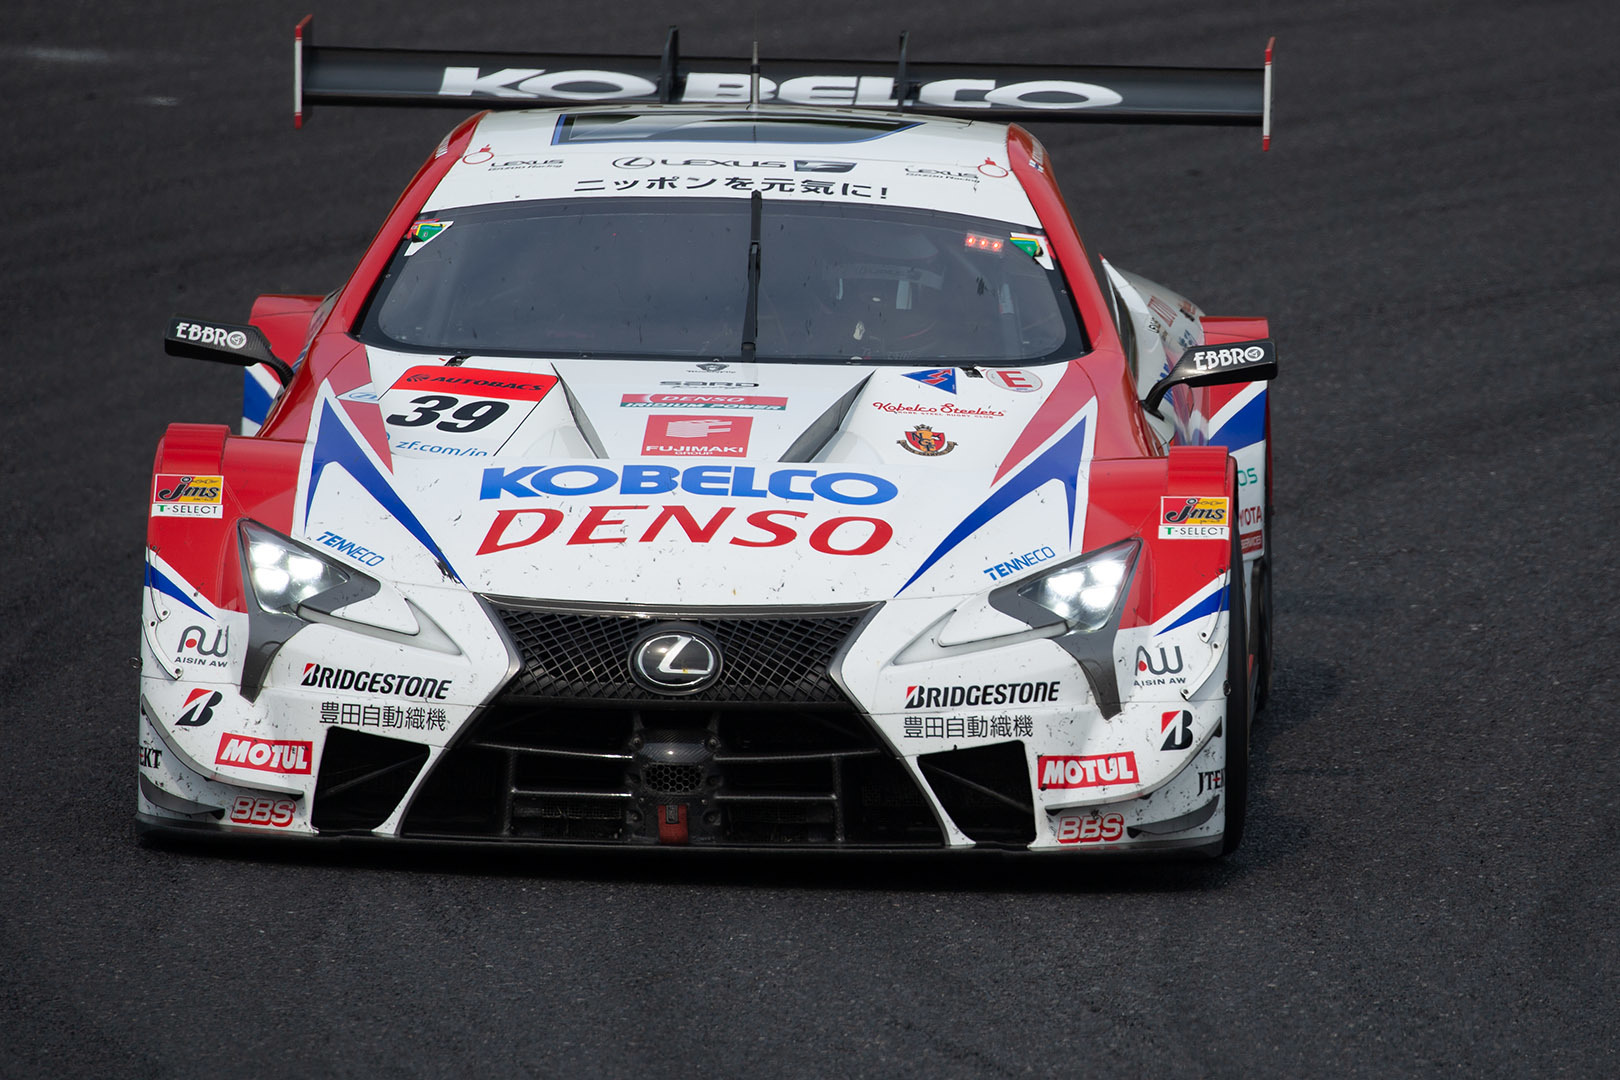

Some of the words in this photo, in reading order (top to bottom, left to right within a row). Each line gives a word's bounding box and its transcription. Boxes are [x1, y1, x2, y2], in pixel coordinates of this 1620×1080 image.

[438, 66, 1123, 109] KOBELCO
[491, 159, 564, 167] LEXUS
[660, 159, 787, 168] LEXUS
[904, 168, 979, 178] LEXUS
[176, 322, 248, 349] EBBRO
[1193, 346, 1265, 371] EBBRO
[429, 376, 544, 392] AUTOBACS
[661, 395, 745, 403] DENSO
[710, 403, 782, 411] POWER
[872, 402, 937, 413] Kobelco
[940, 403, 1005, 417] Steelers
[386, 395, 510, 433] 39
[646, 445, 744, 453] FUJIMAKI
[158, 476, 220, 501] jms
[480, 465, 898, 505] KOBELCO
[157, 504, 218, 515] T-SELECT
[1165, 498, 1225, 523] jms
[475, 505, 893, 556] DENSO
[1164, 527, 1225, 536] T-SELECT
[316, 531, 385, 567] TENNECO
[983, 546, 1056, 581] TENNECO
[174, 656, 206, 665] AISIN
[208, 660, 228, 668] AW
[301, 663, 452, 699] BRIDGESTONE
[1133, 679, 1163, 688] AISIN
[905, 681, 1061, 709] BRIDGESTONE
[319, 701, 447, 731] 豊田自動織機
[903, 715, 1034, 739] 豊田自動織機
[220, 738, 308, 770] MOTUL
[1042, 756, 1134, 784] MOTUL
[231, 796, 296, 828] BBS
[1057, 813, 1124, 844] BBS
